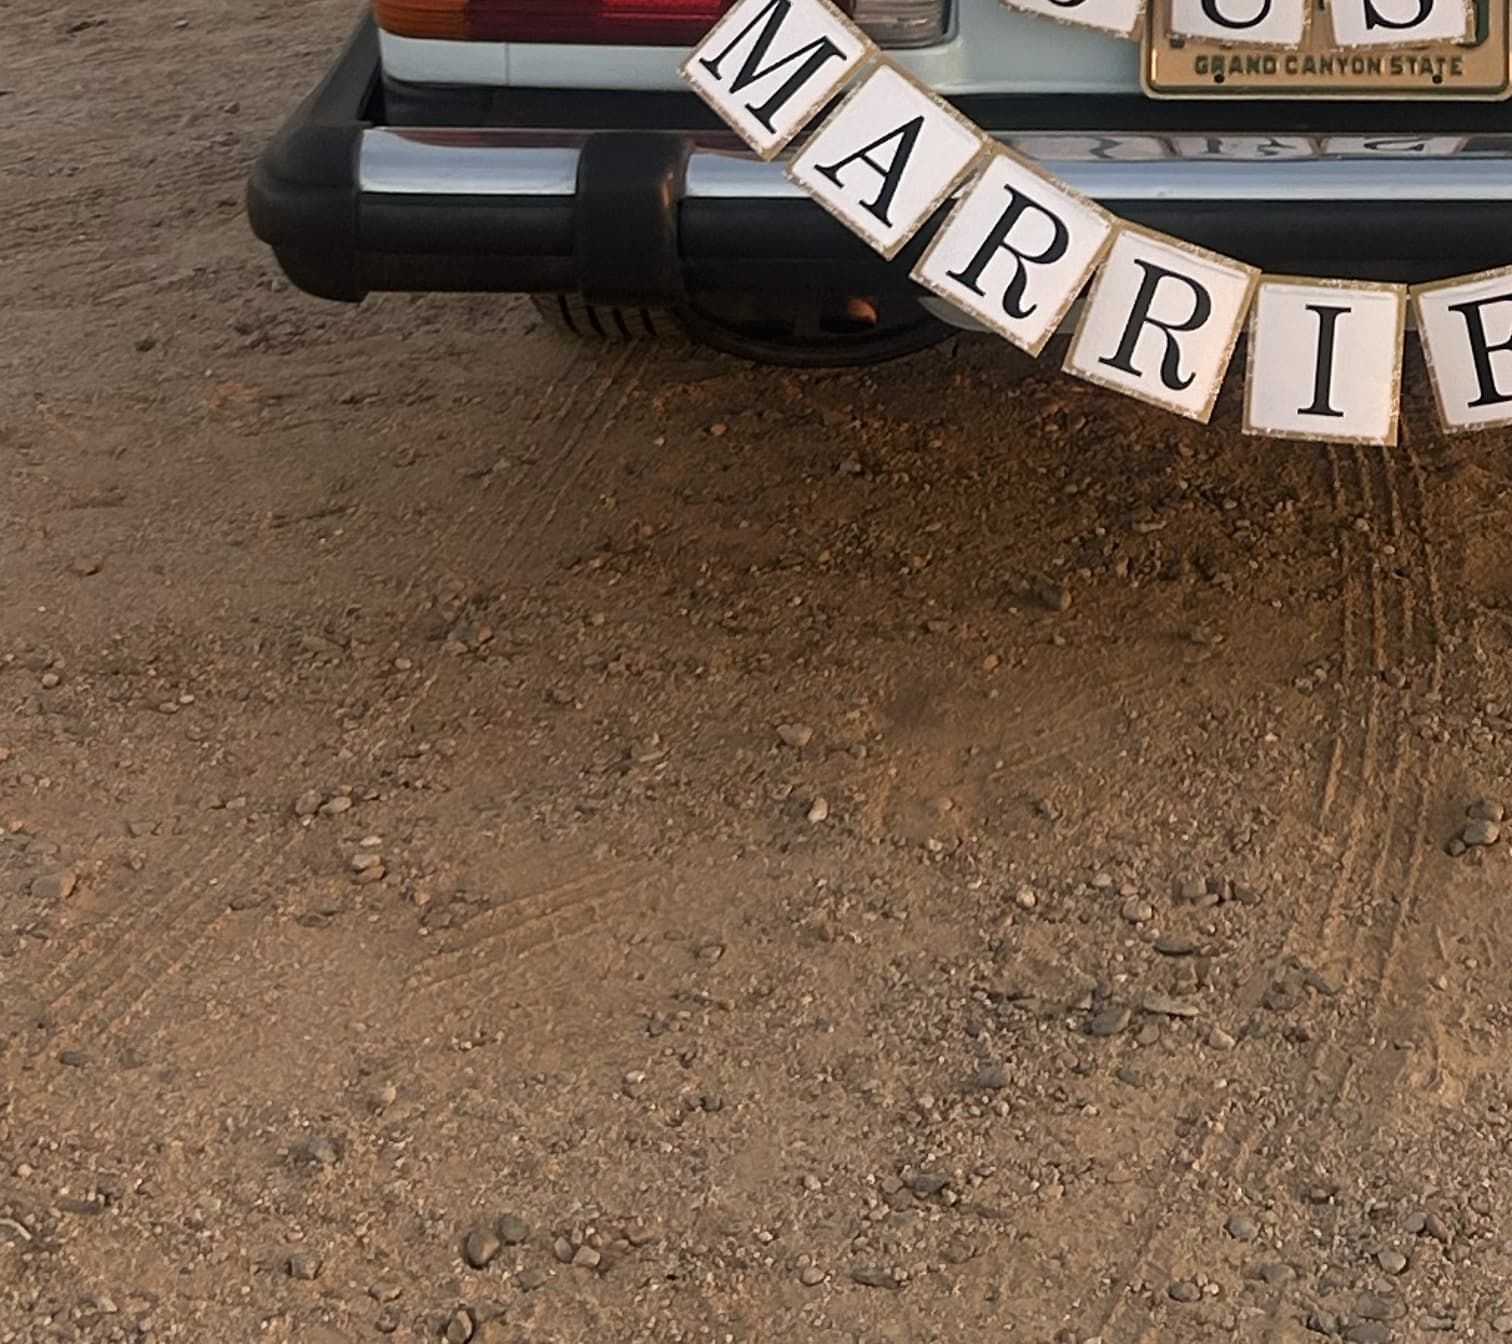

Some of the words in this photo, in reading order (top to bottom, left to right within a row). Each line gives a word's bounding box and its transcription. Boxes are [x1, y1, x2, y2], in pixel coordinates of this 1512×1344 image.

[1193, 55, 1277, 76] GRAND
[1284, 54, 1382, 77] CANYON
[1389, 54, 1463, 77] STATE
